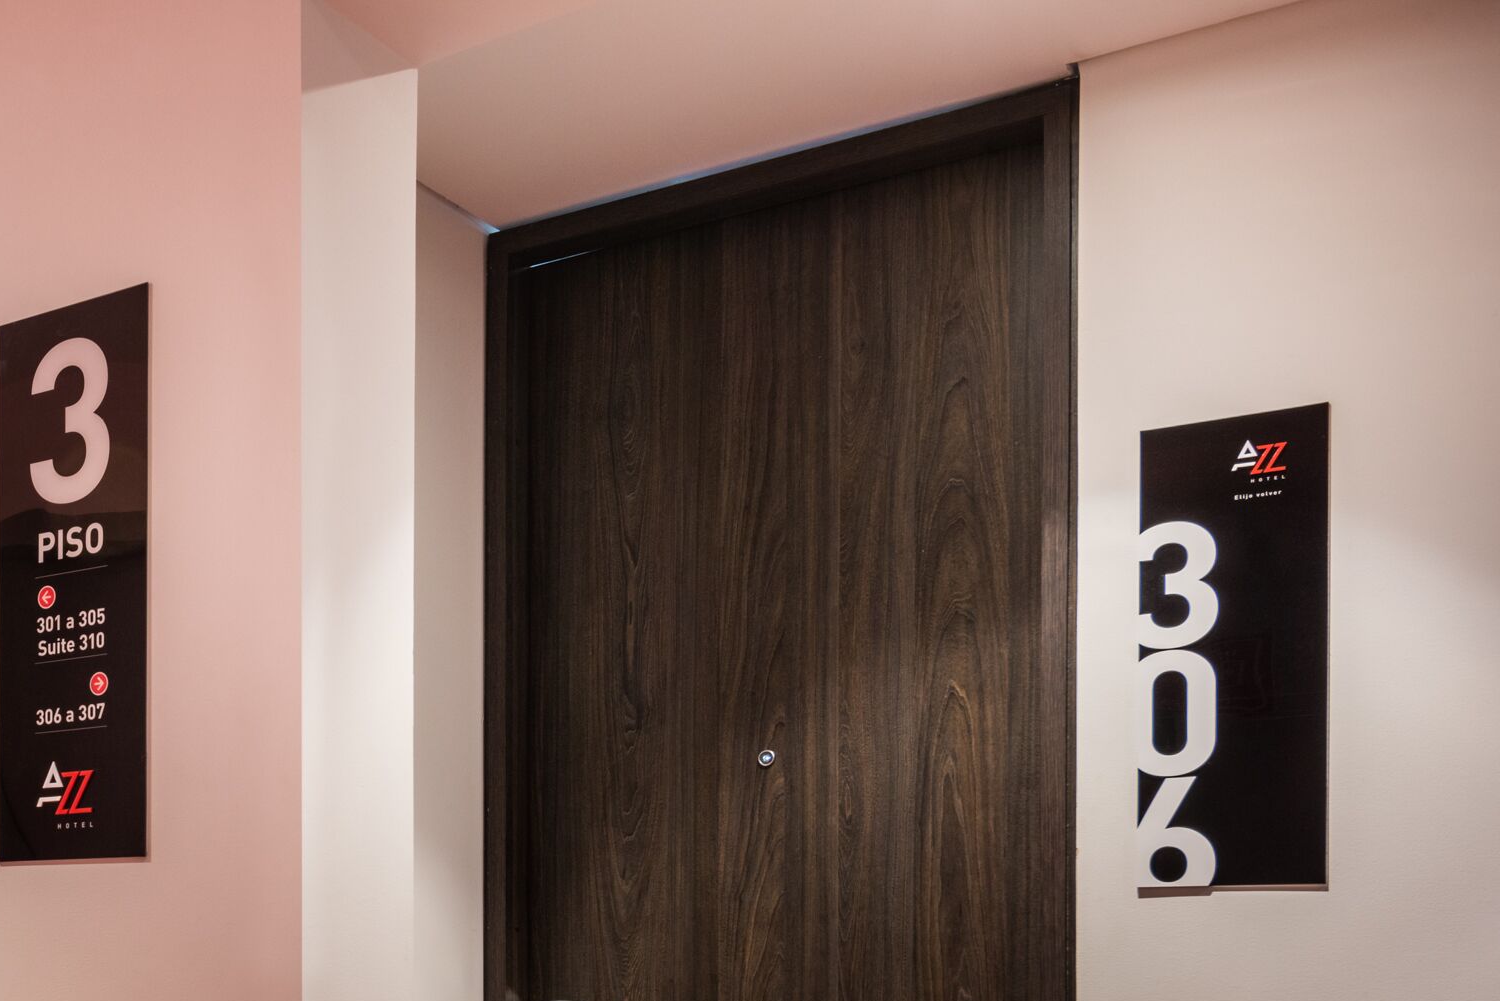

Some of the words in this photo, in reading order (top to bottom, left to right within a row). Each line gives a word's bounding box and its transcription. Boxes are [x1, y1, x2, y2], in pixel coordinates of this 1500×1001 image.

[29, 337, 110, 504] 3
[1231, 439, 1288, 475] AZZ
[1250, 474, 1286, 483] HOTEL
[1256, 490, 1282, 498] volver
[38, 522, 104, 563] PISO
[36, 614, 61, 633] 301
[66, 616, 75, 629] a
[78, 607, 106, 628] 305
[38, 638, 75, 656] Suite
[79, 631, 105, 651] 310
[36, 707, 62, 726] 306
[66, 709, 74, 722] a
[78, 702, 106, 721] 307
[1138, 520, 1219, 887] 306
[36, 761, 95, 815] AZZ
[57, 821, 94, 829] HOTEL
